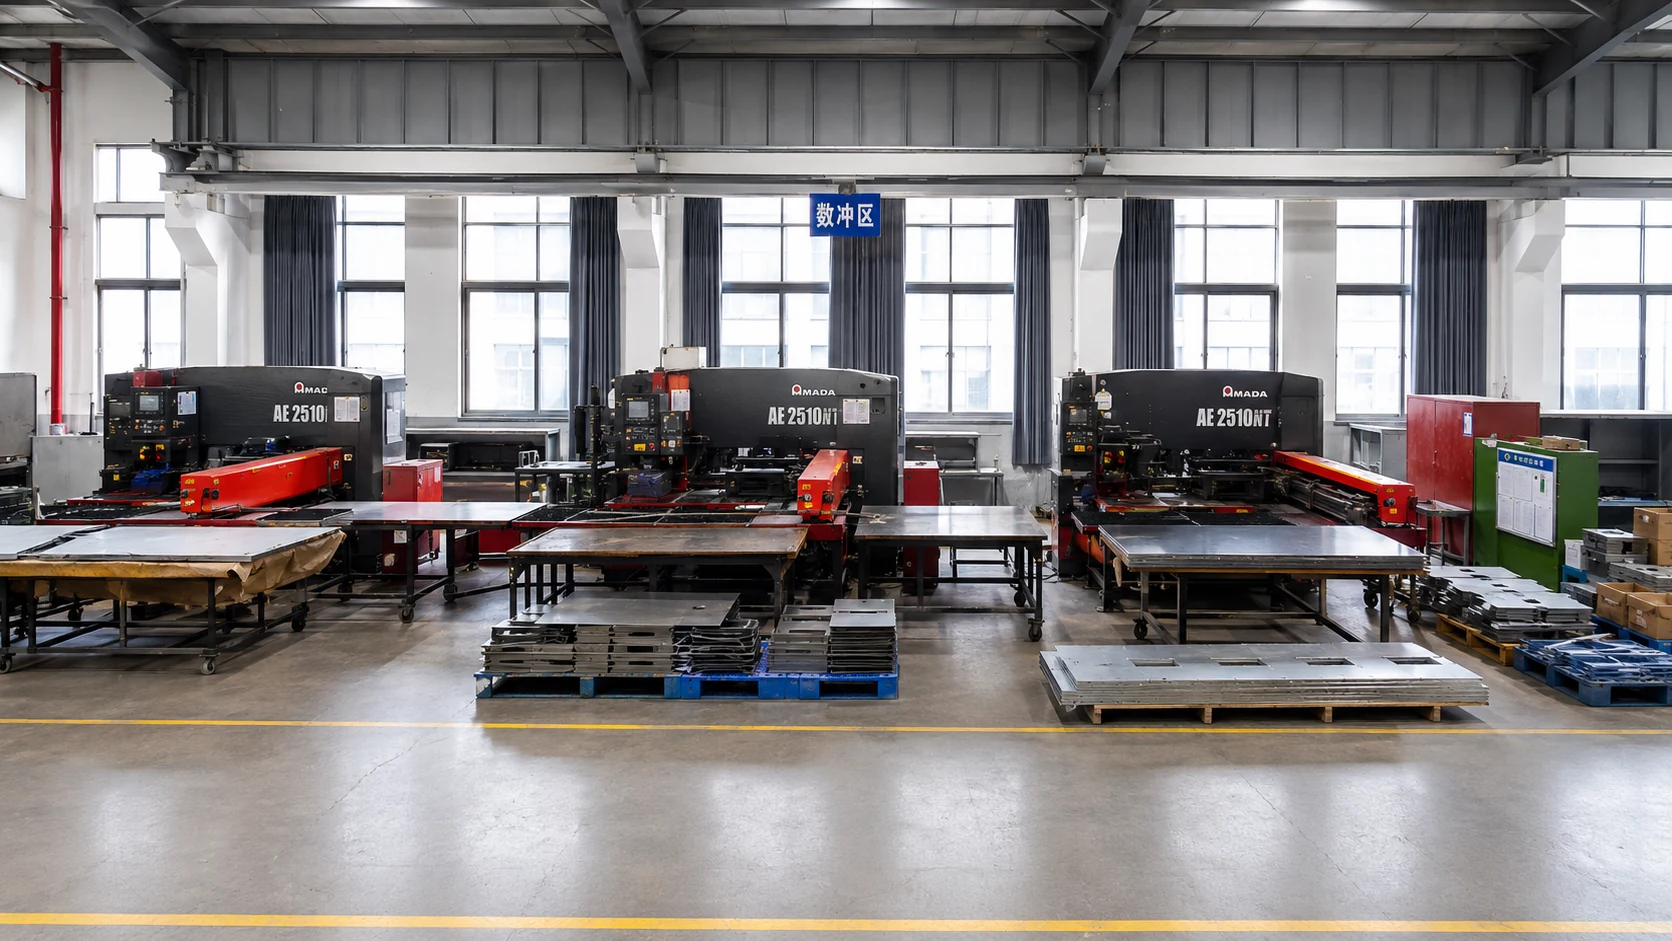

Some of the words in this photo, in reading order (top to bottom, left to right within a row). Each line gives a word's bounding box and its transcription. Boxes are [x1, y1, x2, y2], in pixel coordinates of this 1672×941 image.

[816, 202, 874, 228] 数冲区
[792, 384, 836, 396] AMADA
[1222, 385, 1268, 398] AMADA
[272, 404, 290, 423] AE
[292, 404, 328, 423] 2510
[767, 406, 785, 425] AE
[1196, 408, 1214, 427] AE
[1216, 408, 1273, 427] 2510NT
